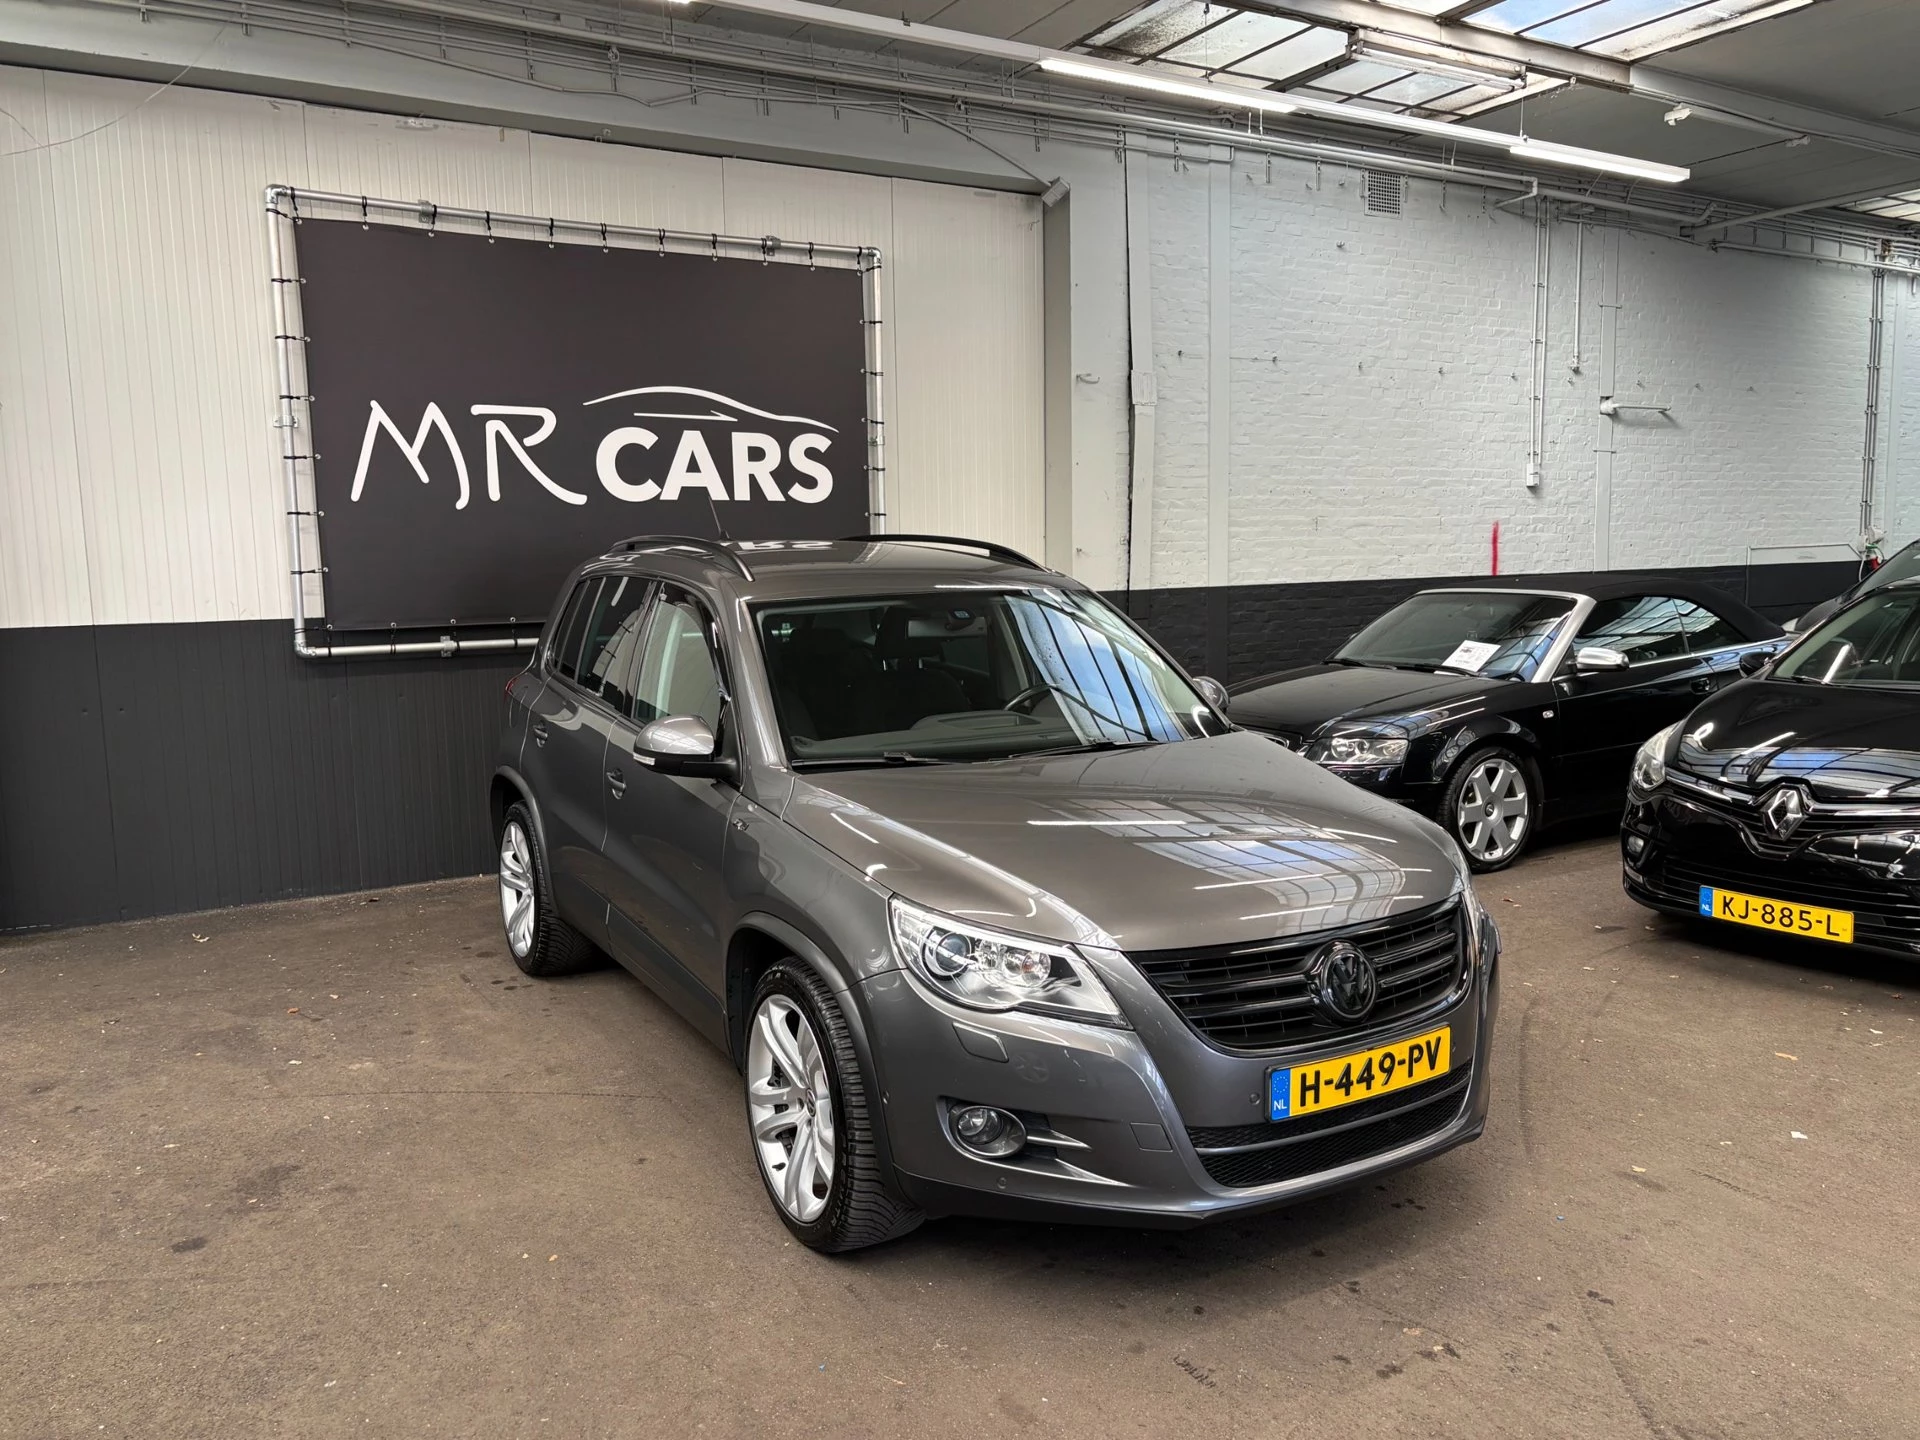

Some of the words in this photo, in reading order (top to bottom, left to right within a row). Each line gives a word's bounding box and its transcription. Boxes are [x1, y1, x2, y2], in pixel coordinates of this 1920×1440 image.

[351, 400, 588, 510] MR
[595, 427, 834, 504] CARS
[1722, 895, 1840, 937] KJ-885-L
[1273, 1098, 1288, 1111] NL
[1299, 1036, 1442, 1108] H-449-PV
